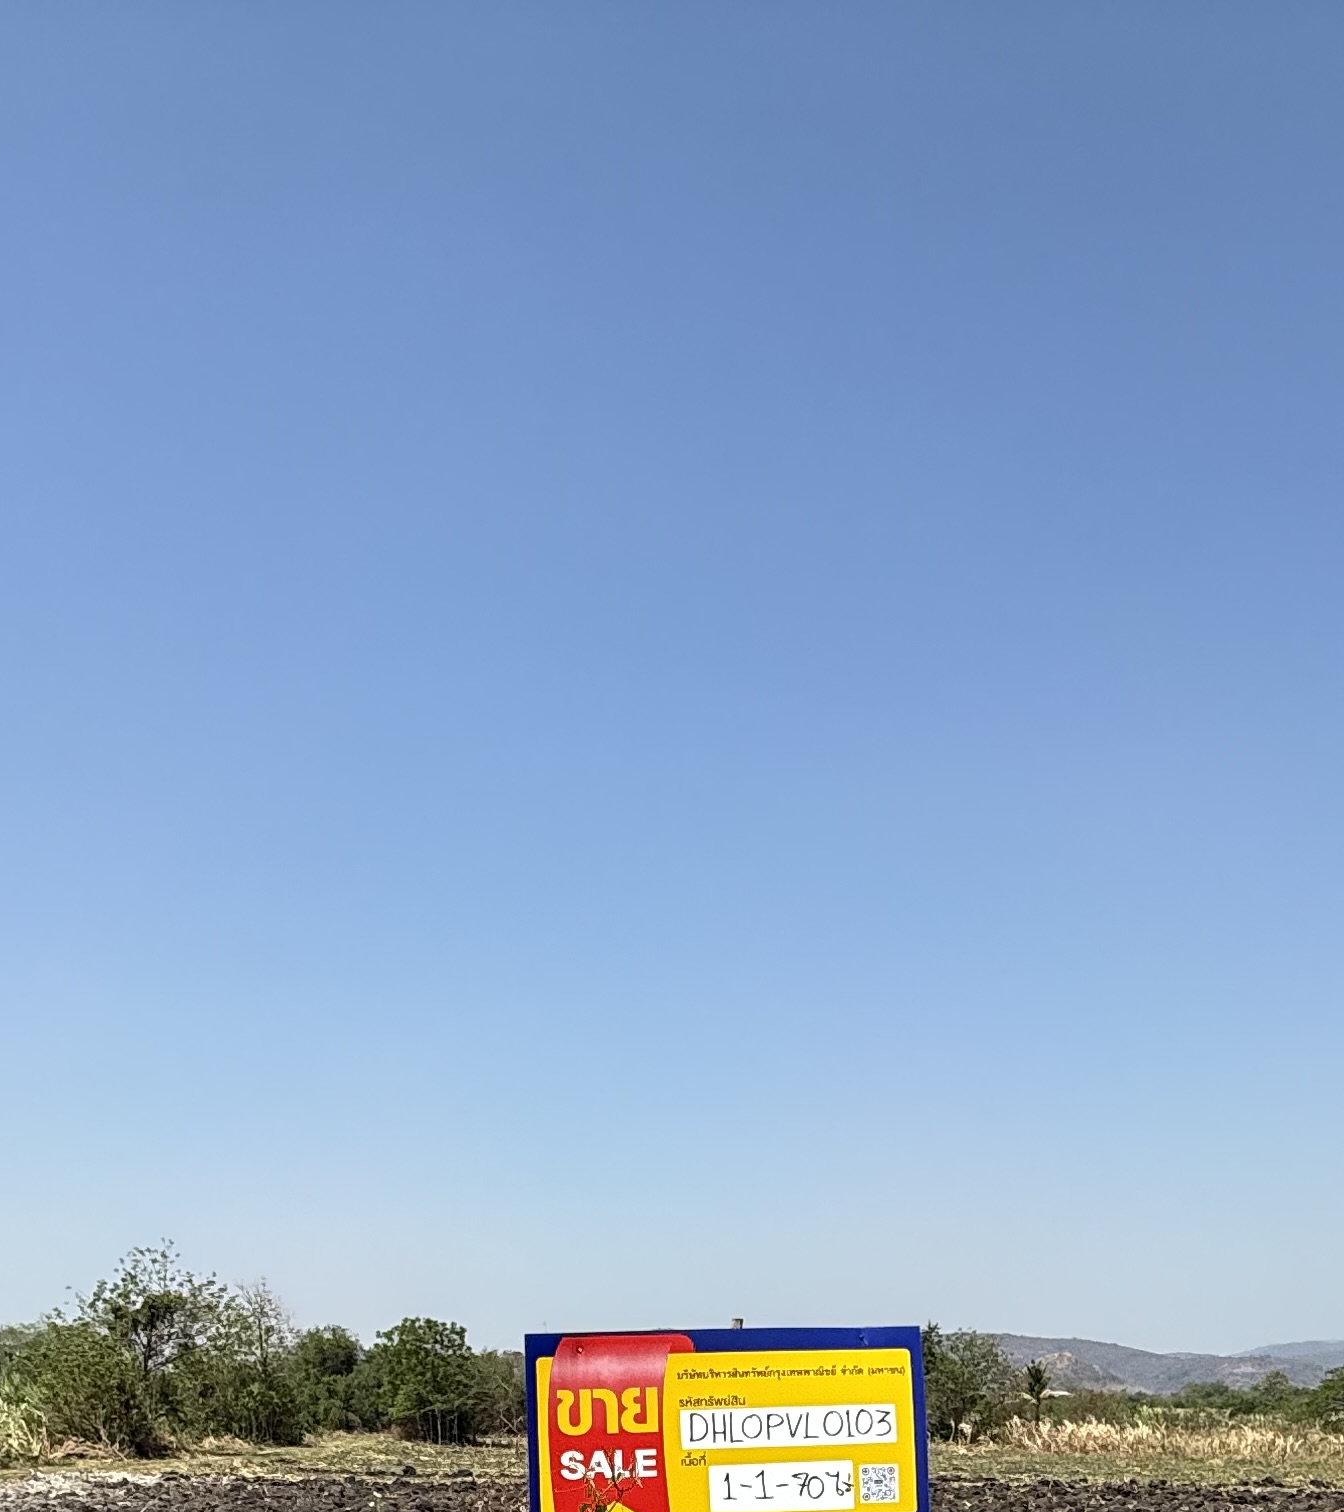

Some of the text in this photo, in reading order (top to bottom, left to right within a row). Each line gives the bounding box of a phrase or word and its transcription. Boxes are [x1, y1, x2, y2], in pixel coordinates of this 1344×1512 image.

[557, 1387, 659, 1436] ขาย
[679, 1395, 746, 1407] รหัสทรัพย์สิน
[560, 1449, 658, 1480] SALE
[681, 1451, 706, 1467] เนื้อที่
